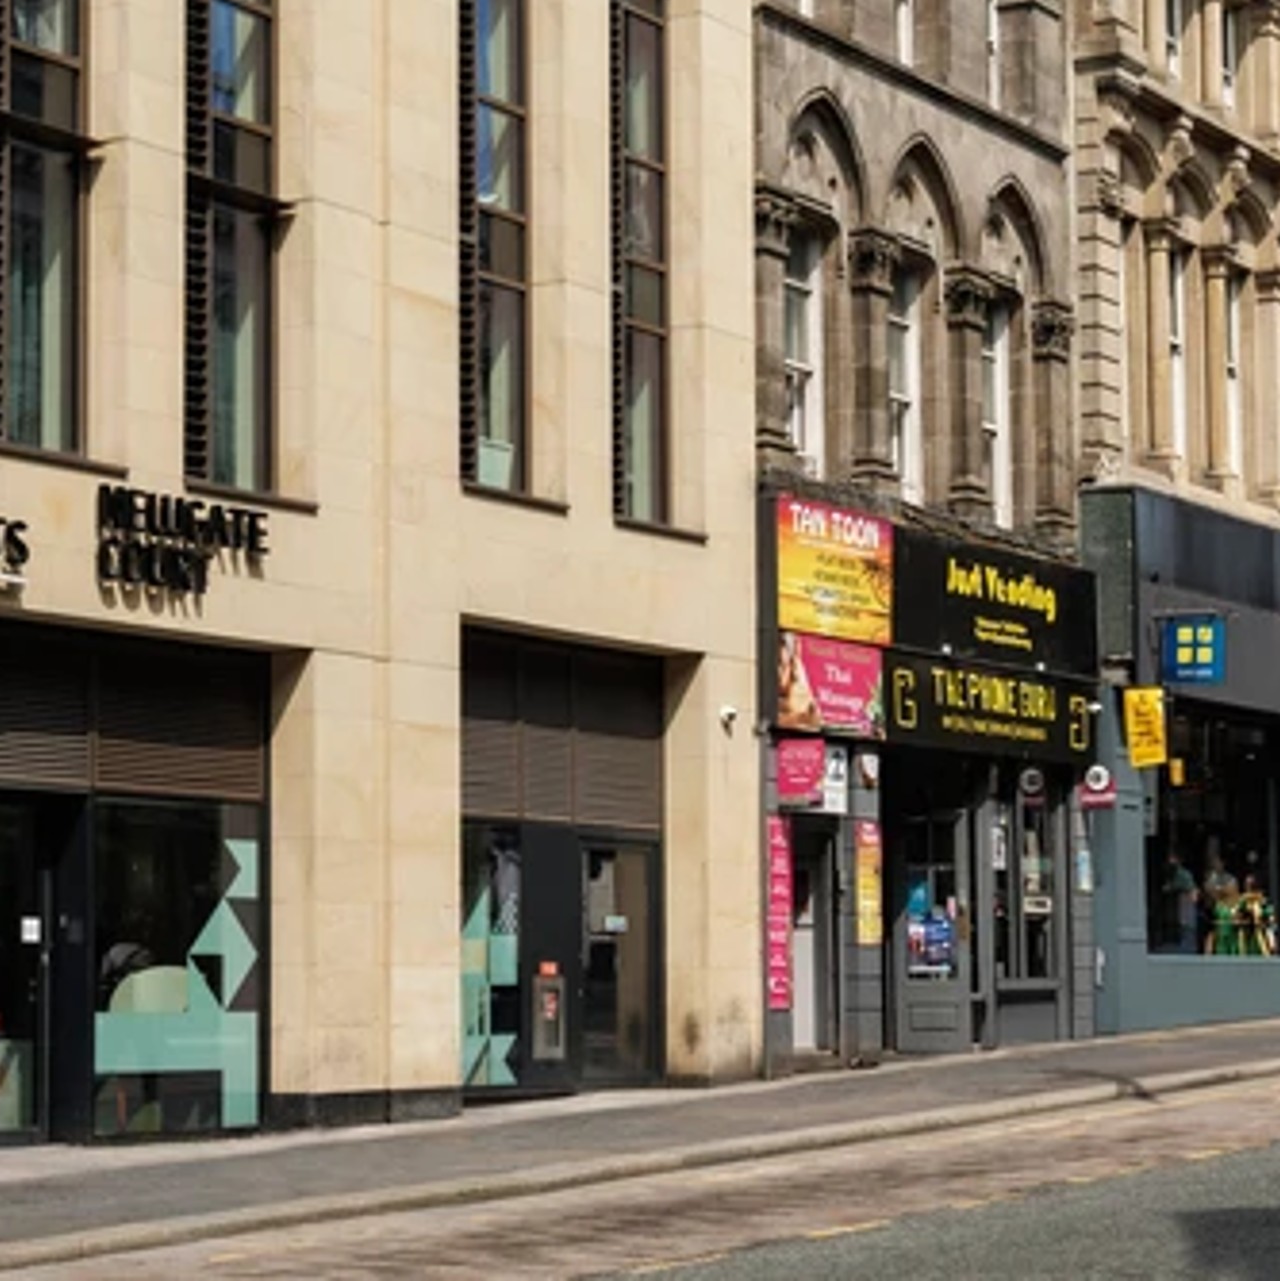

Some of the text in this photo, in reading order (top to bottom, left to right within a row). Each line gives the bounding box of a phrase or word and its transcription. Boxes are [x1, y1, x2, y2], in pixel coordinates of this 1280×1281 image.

[789, 503, 825, 537] TAN
[831, 512, 879, 549] TOON
[946, 558, 983, 598] Just
[931, 666, 966, 708] THE
[968, 672, 1018, 717] PHONE
